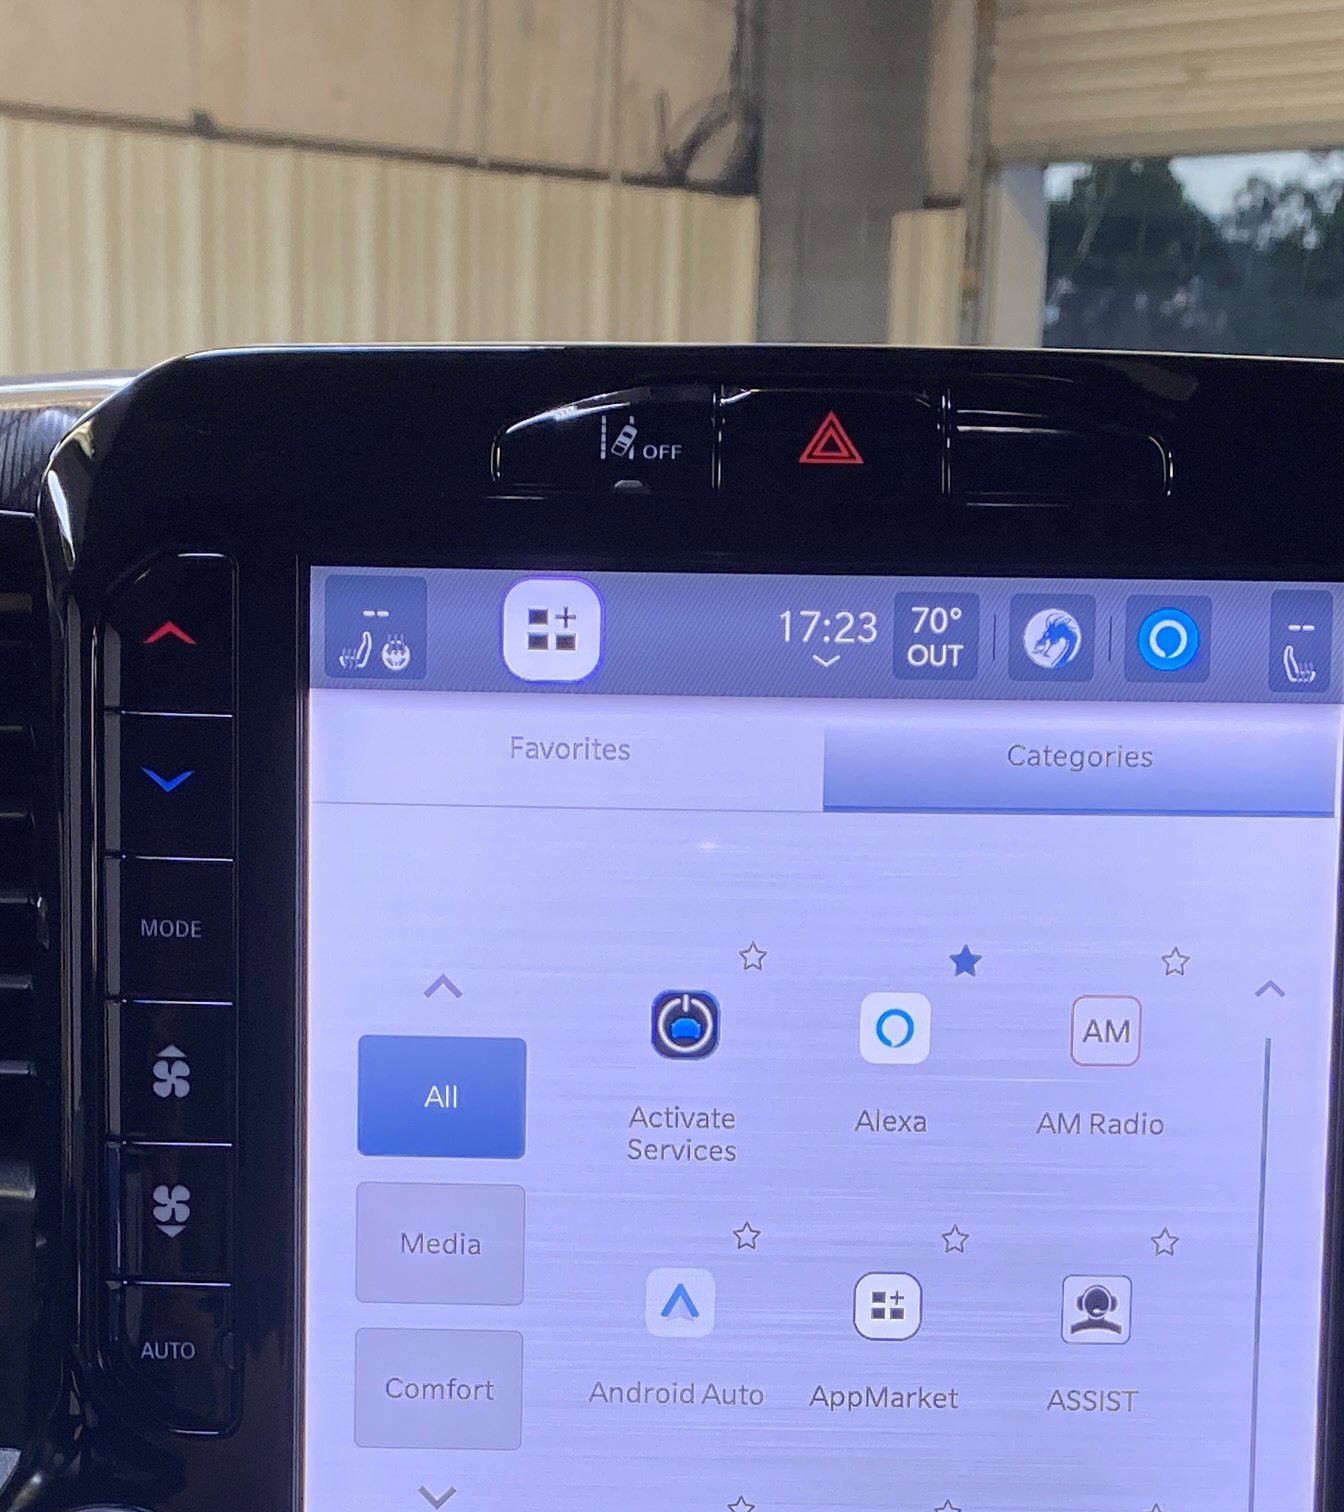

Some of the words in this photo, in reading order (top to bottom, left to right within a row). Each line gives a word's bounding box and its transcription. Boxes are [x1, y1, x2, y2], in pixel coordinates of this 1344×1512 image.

[642, 444, 683, 460] OFF
[779, 610, 879, 647] 17:23
[911, 607, 963, 636] 70°
[907, 642, 965, 668] OUT
[509, 733, 632, 764] Favorites
[1007, 742, 1154, 774] Categories
[140, 919, 202, 939] MODE
[1082, 1019, 1130, 1043] AM
[424, 1085, 458, 1109] All
[629, 1106, 736, 1130] Activate
[854, 1109, 927, 1133] Alexa
[1036, 1112, 1081, 1135] AM
[1090, 1113, 1165, 1136] Radio
[627, 1138, 737, 1162] Services
[400, 1232, 482, 1256] Media
[141, 1342, 196, 1360] AUTO
[385, 1377, 495, 1401] Comfort
[589, 1381, 695, 1405] Android
[701, 1383, 765, 1406] Auto
[810, 1385, 959, 1412] AppMarket
[1047, 1390, 1139, 1412] ASSIST
